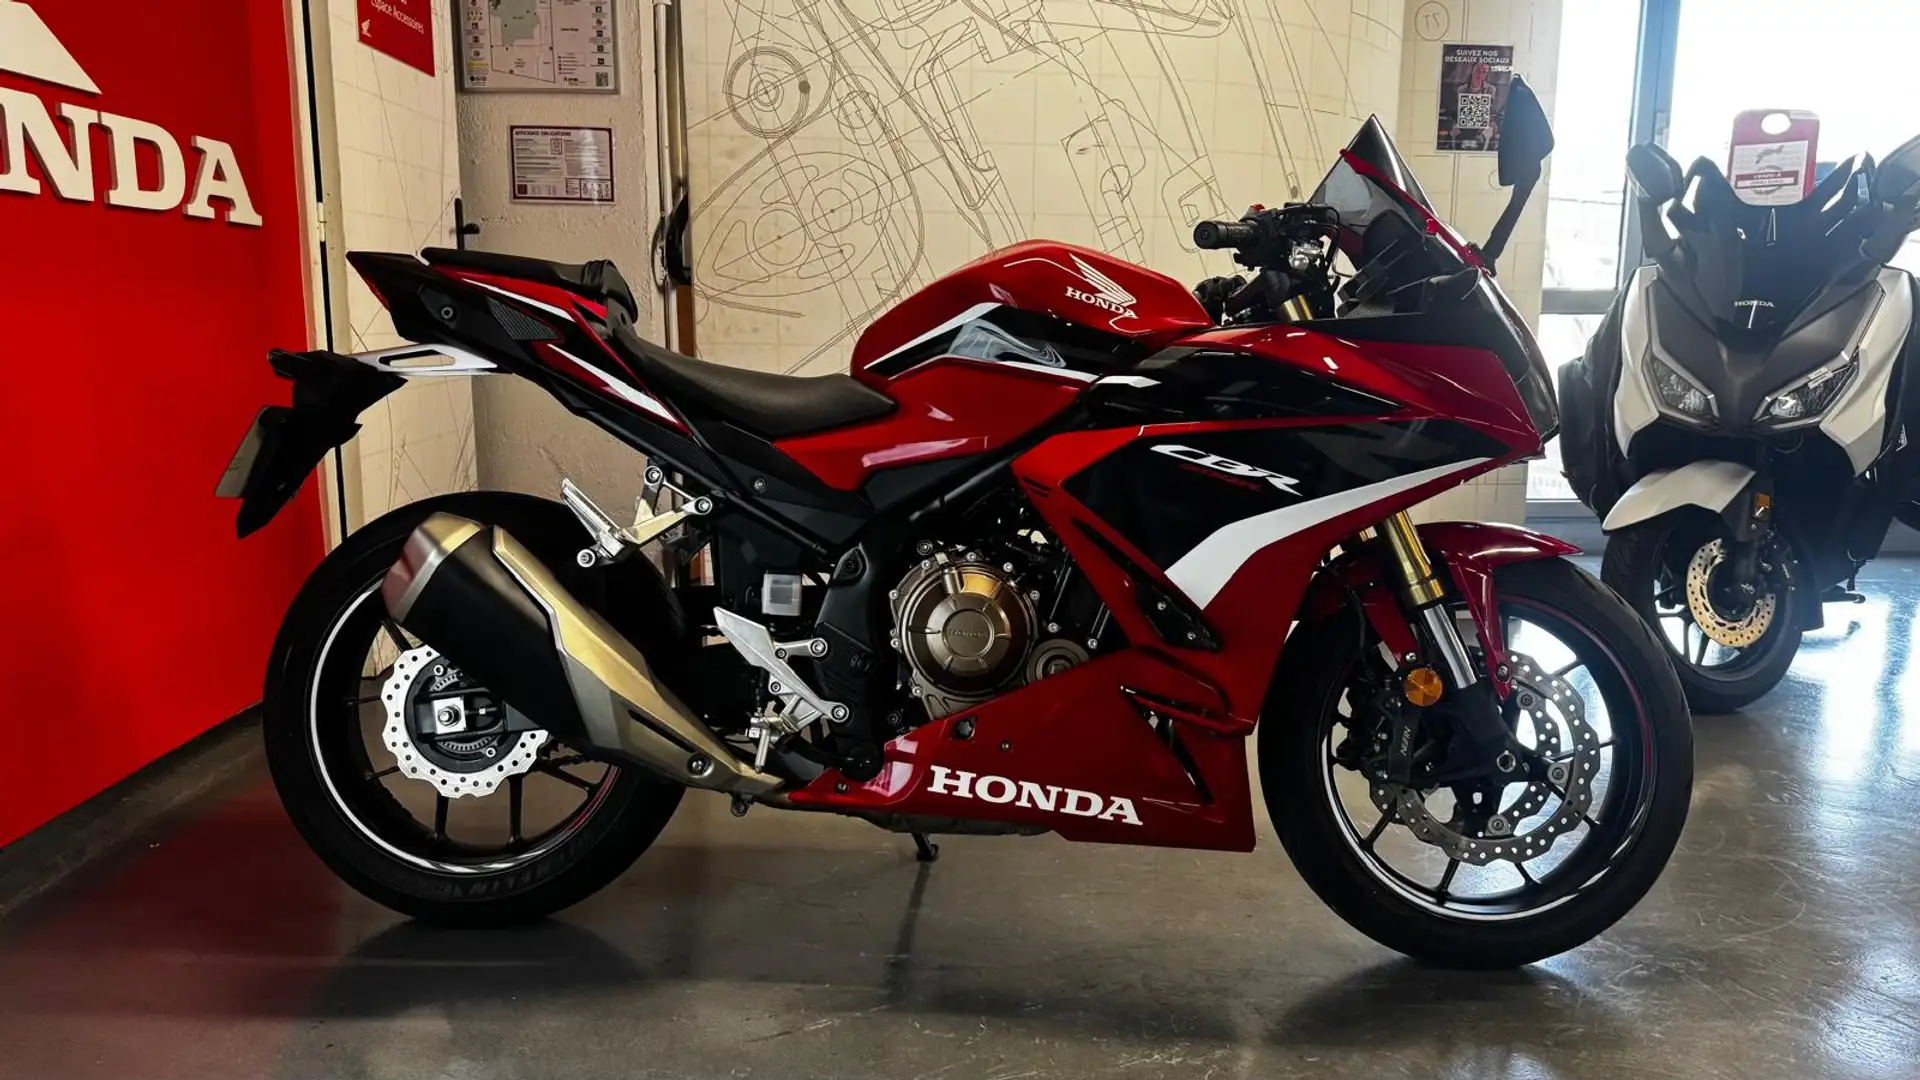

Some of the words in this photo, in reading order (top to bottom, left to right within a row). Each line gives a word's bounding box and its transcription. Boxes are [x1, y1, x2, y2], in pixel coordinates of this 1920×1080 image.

[1444, 55, 1477, 63] RÉSEAUX
[1479, 56, 1510, 64] SOCIAUX
[1456, 49, 1481, 57] SUIVEZ
[1065, 286, 1139, 319] HONDA
[1734, 300, 1775, 308] HONDA
[1150, 444, 1303, 497] CBR
[927, 765, 1143, 826] HONDA
